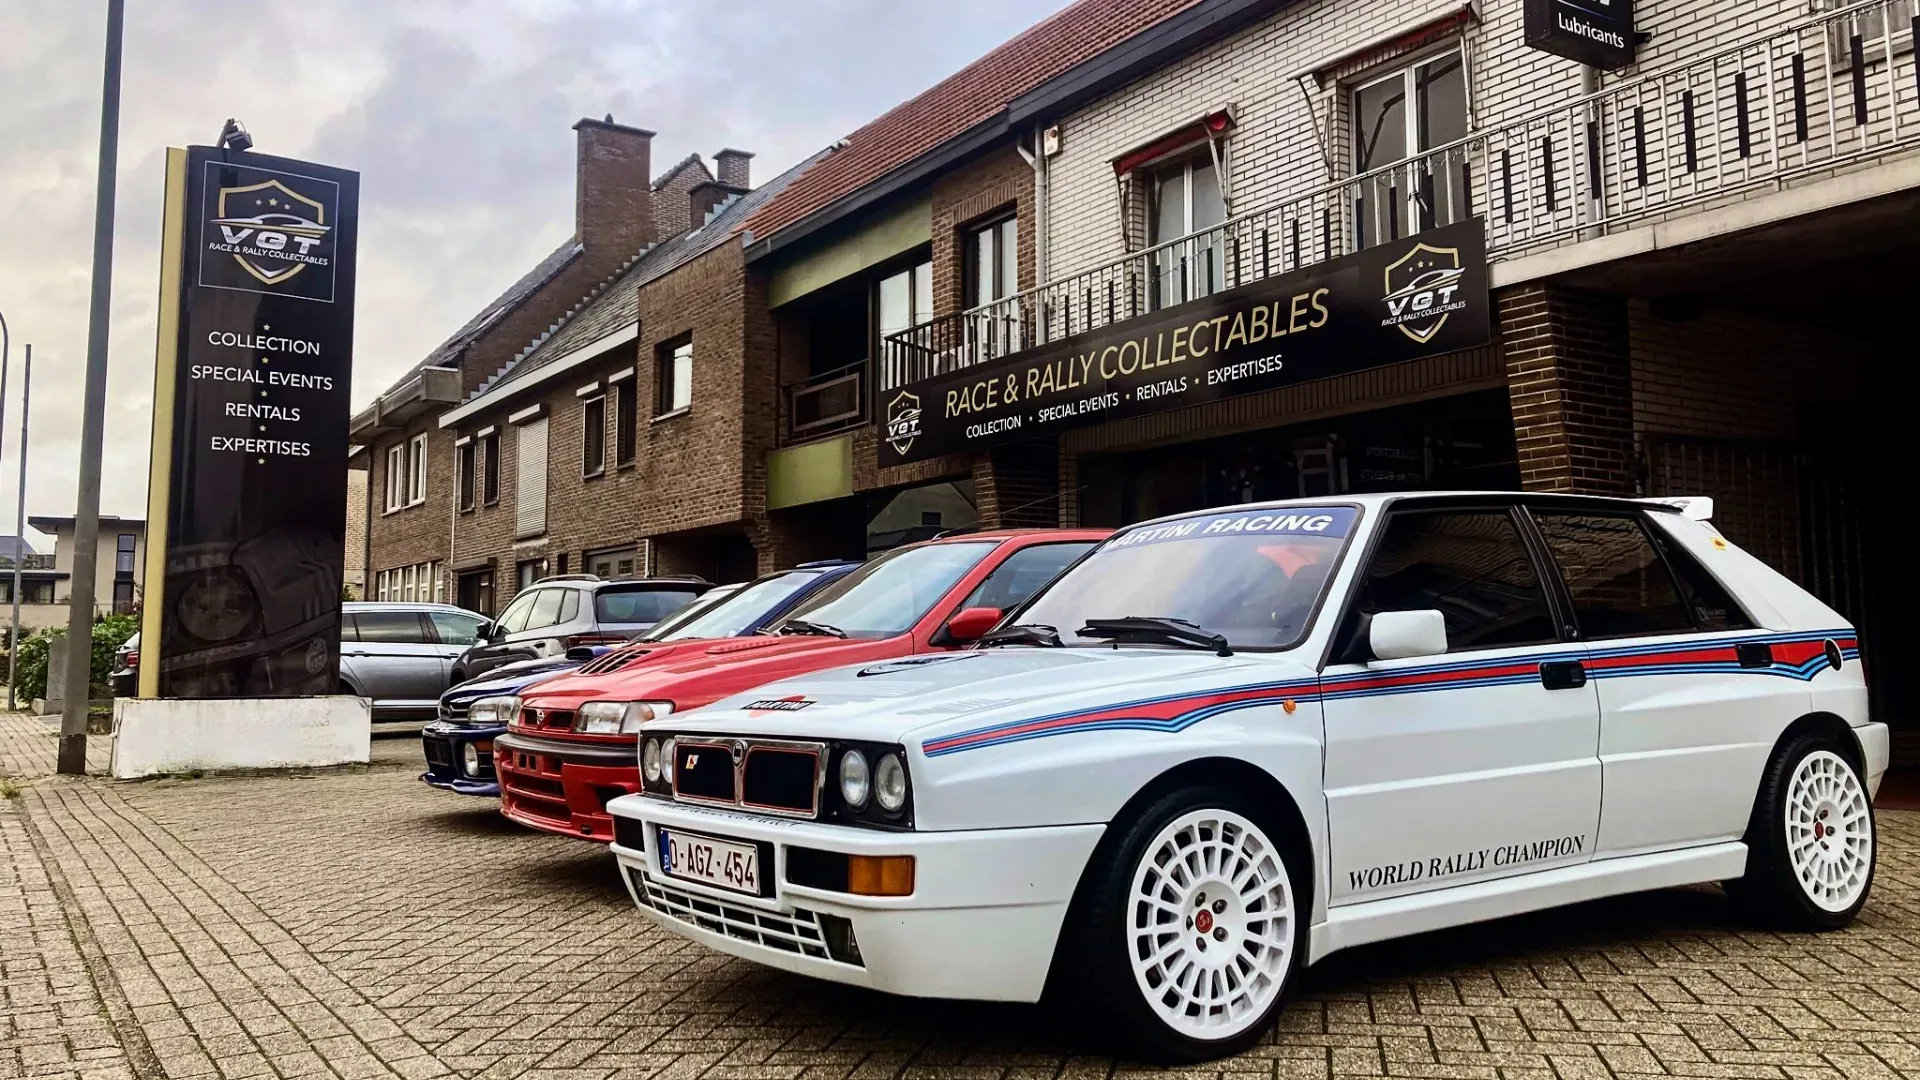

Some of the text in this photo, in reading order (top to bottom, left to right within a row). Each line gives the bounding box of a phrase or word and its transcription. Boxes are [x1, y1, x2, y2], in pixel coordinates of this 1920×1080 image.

[1558, 12, 1625, 48] Lubricants
[220, 225, 321, 255] VGT
[208, 242, 329, 266] RACE & RALLY COLLECTABLES
[1381, 316, 1397, 327] RACE
[1403, 311, 1421, 322] RALLY
[1420, 300, 1467, 318] COLLECTABLES
[1387, 284, 1459, 317] VGT
[208, 331, 321, 356] COLLECTION
[945, 288, 1330, 419] RACE & RALLY COLLECTABLES
[191, 365, 333, 391] SPECIAL EVENTS
[966, 354, 1283, 439] COLLECTION SPECIAL EVENTS RENTALS EXPERTISES
[225, 402, 301, 422] RENTALS
[888, 420, 920, 437] VGT
[211, 436, 311, 457] EXPERTISES
[1203, 515, 1334, 539] RACING
[1349, 834, 1586, 891] WORLD RALLY CHAMPION
